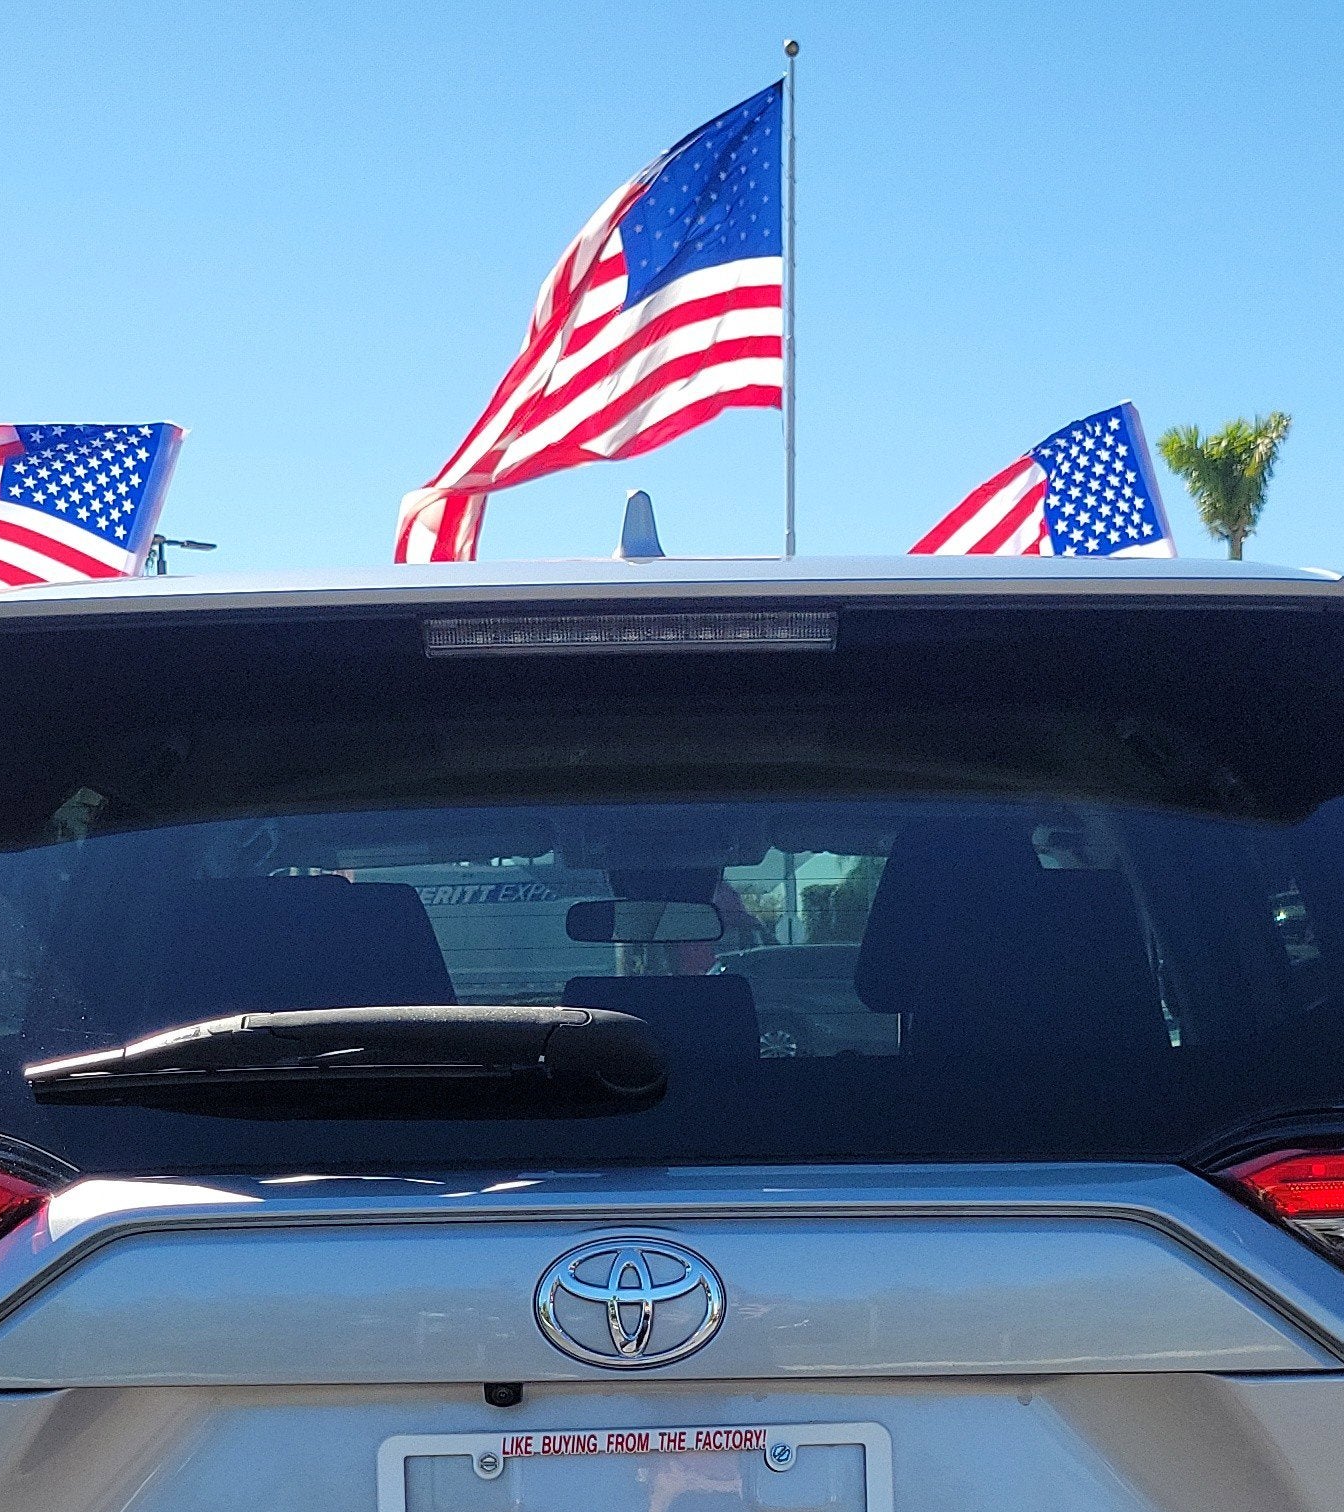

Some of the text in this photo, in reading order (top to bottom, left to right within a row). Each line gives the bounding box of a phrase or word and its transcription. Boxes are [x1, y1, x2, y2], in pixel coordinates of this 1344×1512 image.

[502, 1429, 767, 1456] LIKE BUYING FROM THE FACTORY!
